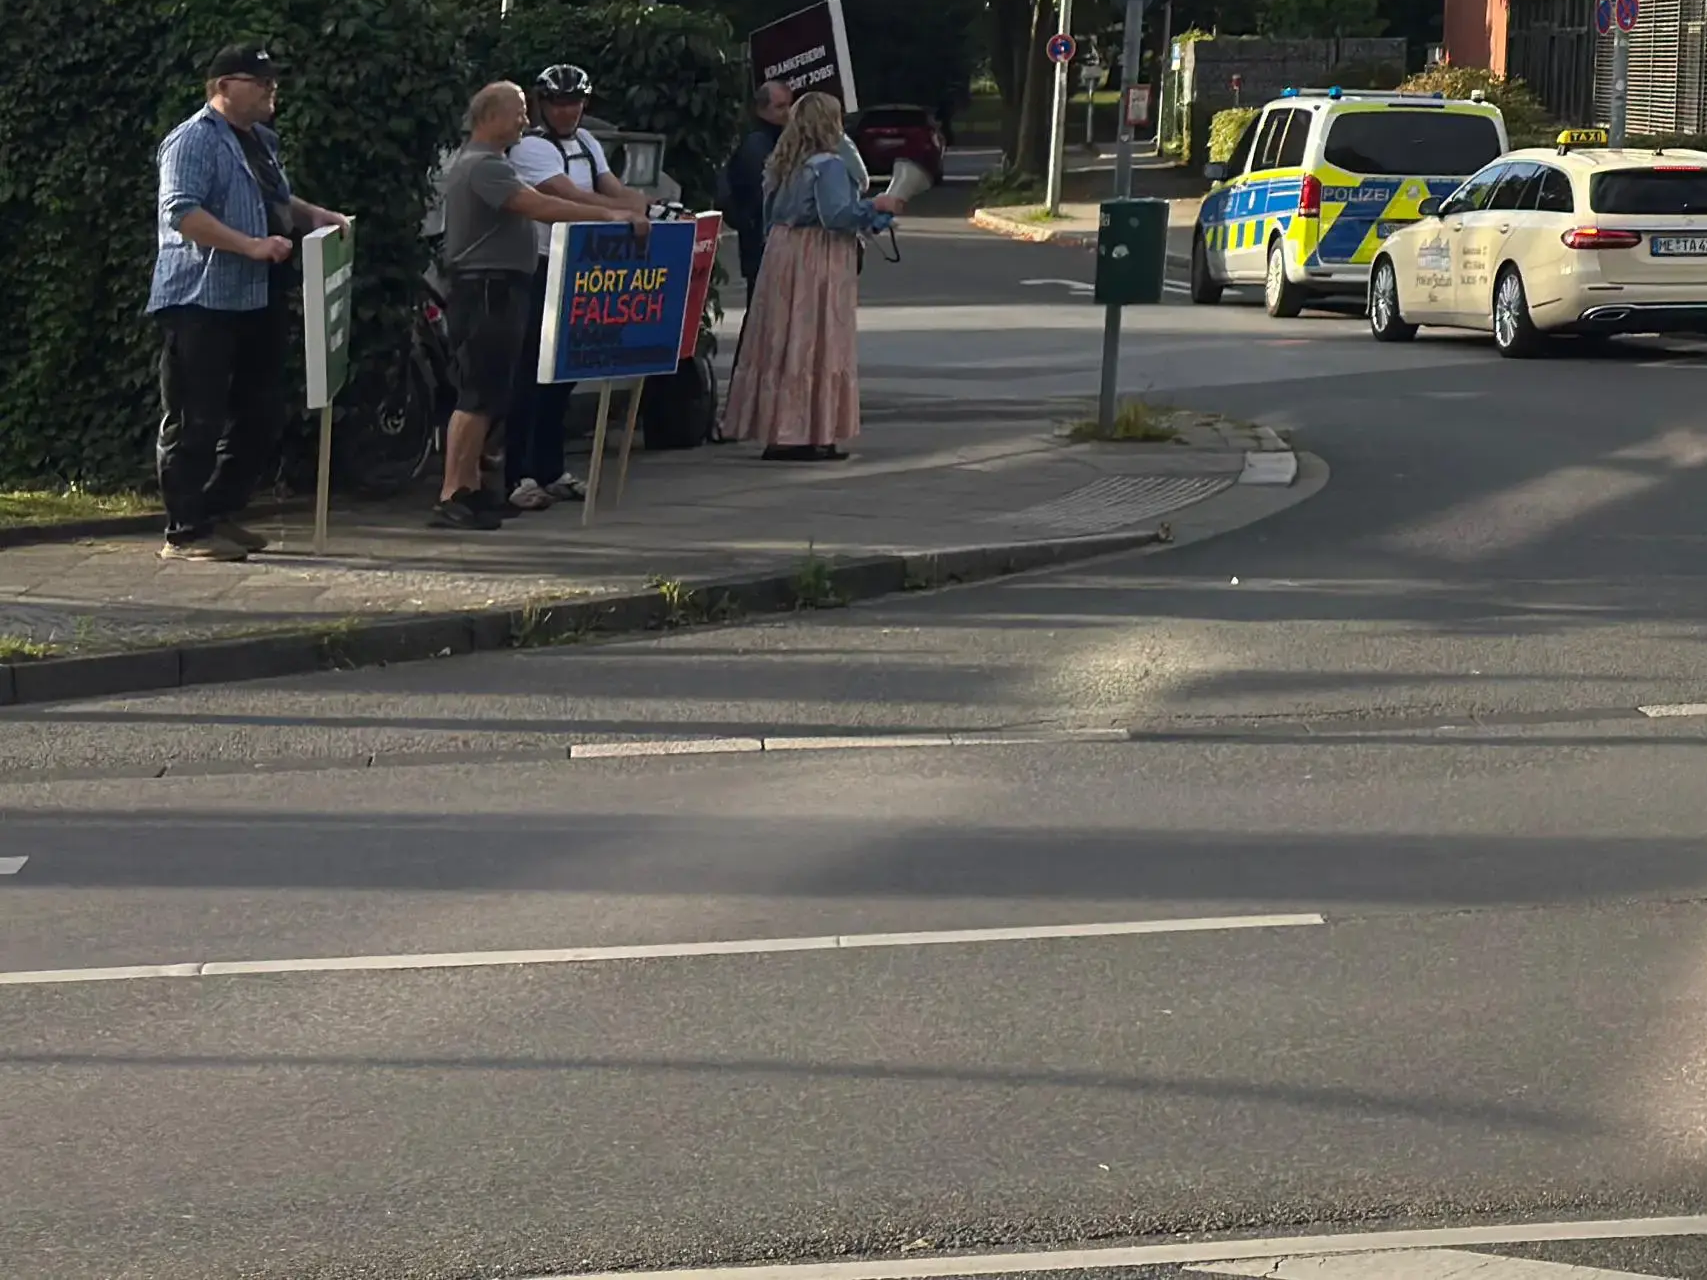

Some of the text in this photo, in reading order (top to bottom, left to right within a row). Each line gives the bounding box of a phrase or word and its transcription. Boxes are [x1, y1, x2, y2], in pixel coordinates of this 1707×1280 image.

[1572, 131, 1601, 142] TAXI
[1323, 187, 1390, 202] POLIZEI
[574, 265, 668, 294] HÖRT AUF
[570, 293, 665, 326] FALSCH
